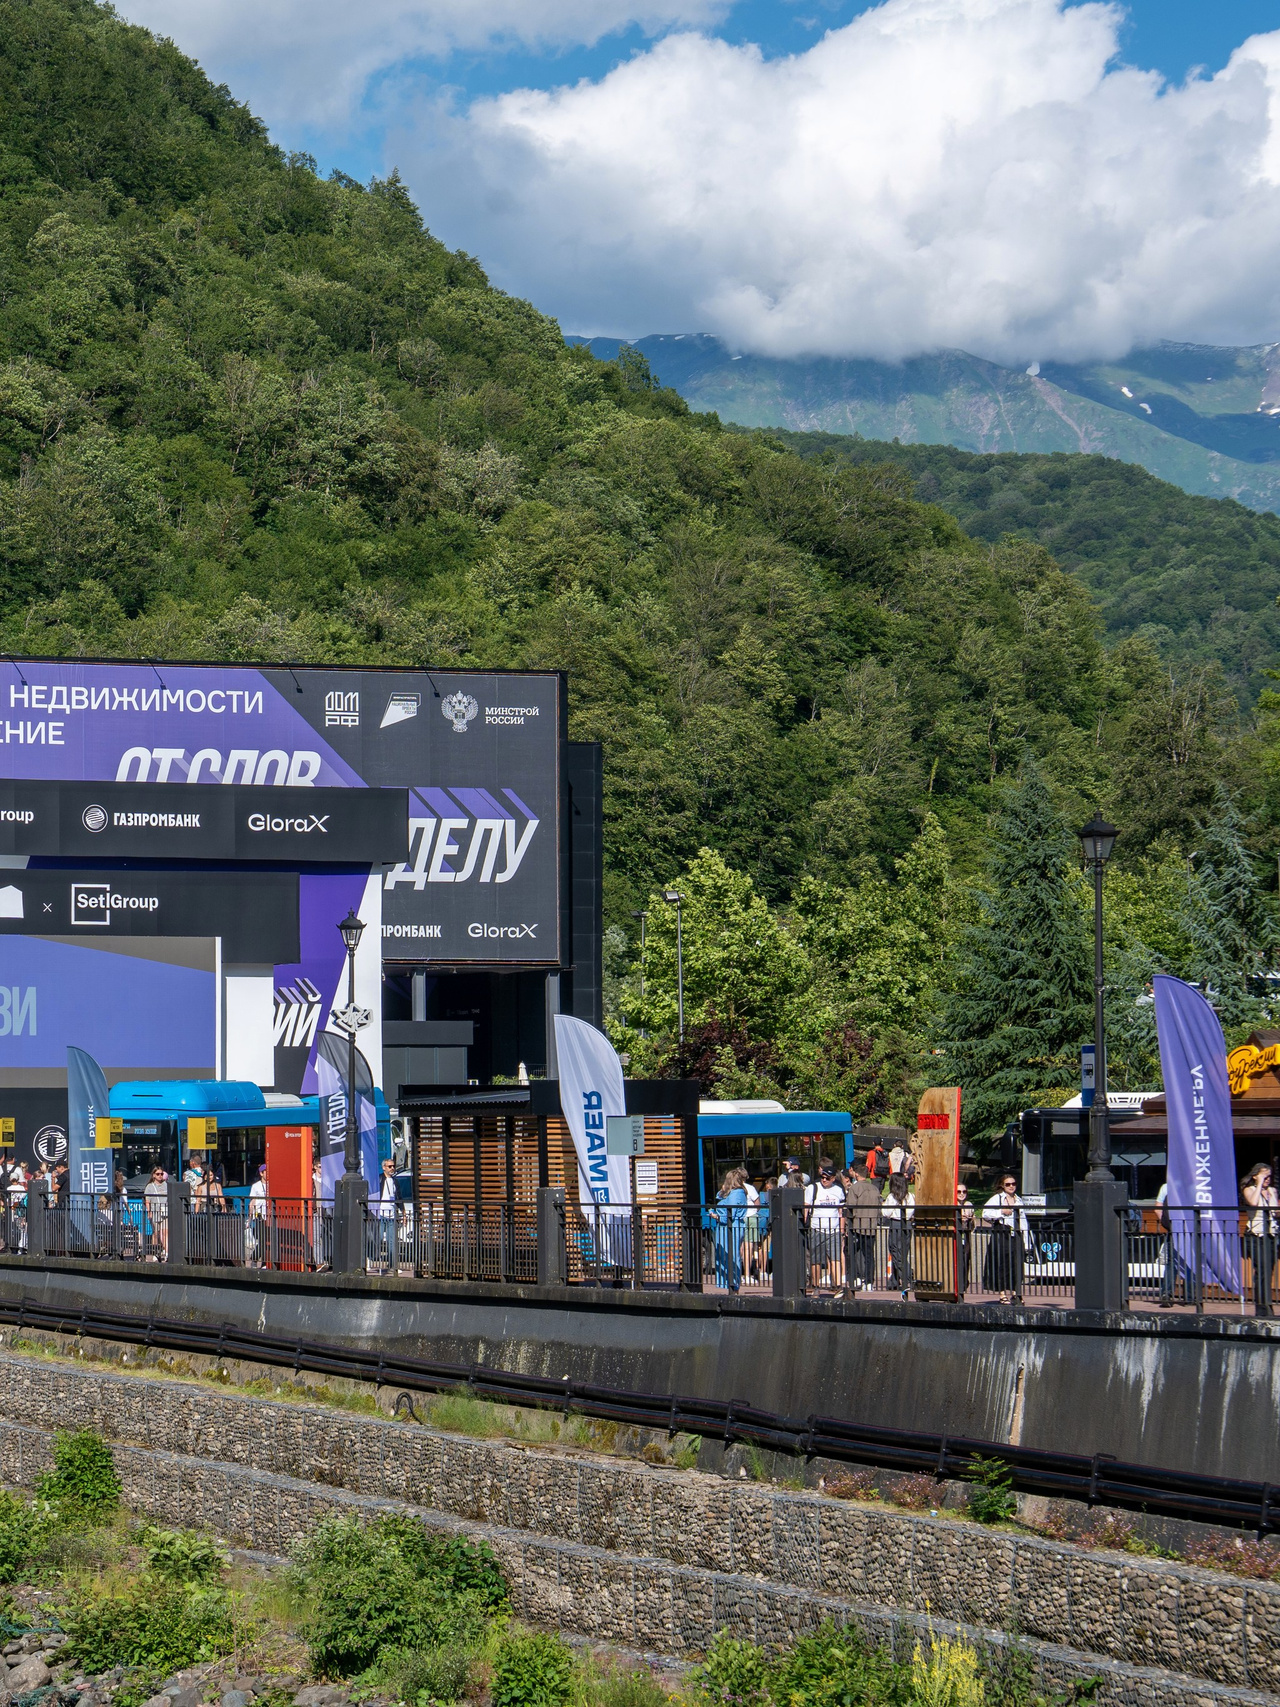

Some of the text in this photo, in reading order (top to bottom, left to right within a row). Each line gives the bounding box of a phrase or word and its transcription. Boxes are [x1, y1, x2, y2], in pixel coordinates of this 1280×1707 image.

[10, 685, 263, 715] НЕДВИЖИМОСТИ
[325, 692, 359, 711] ДОМ
[485, 706, 539, 716] МИНСТРОЙ
[325, 716, 359, 727] РФ
[485, 715, 525, 725] РОССИИ
[114, 812, 200, 828] ГАЗПРОМБАНК
[248, 814, 330, 832] GloraX
[383, 817, 540, 890] ДЕЛУ
[381, 925, 442, 938] ПРОМБАНК
[468, 922, 539, 938] GloraX
